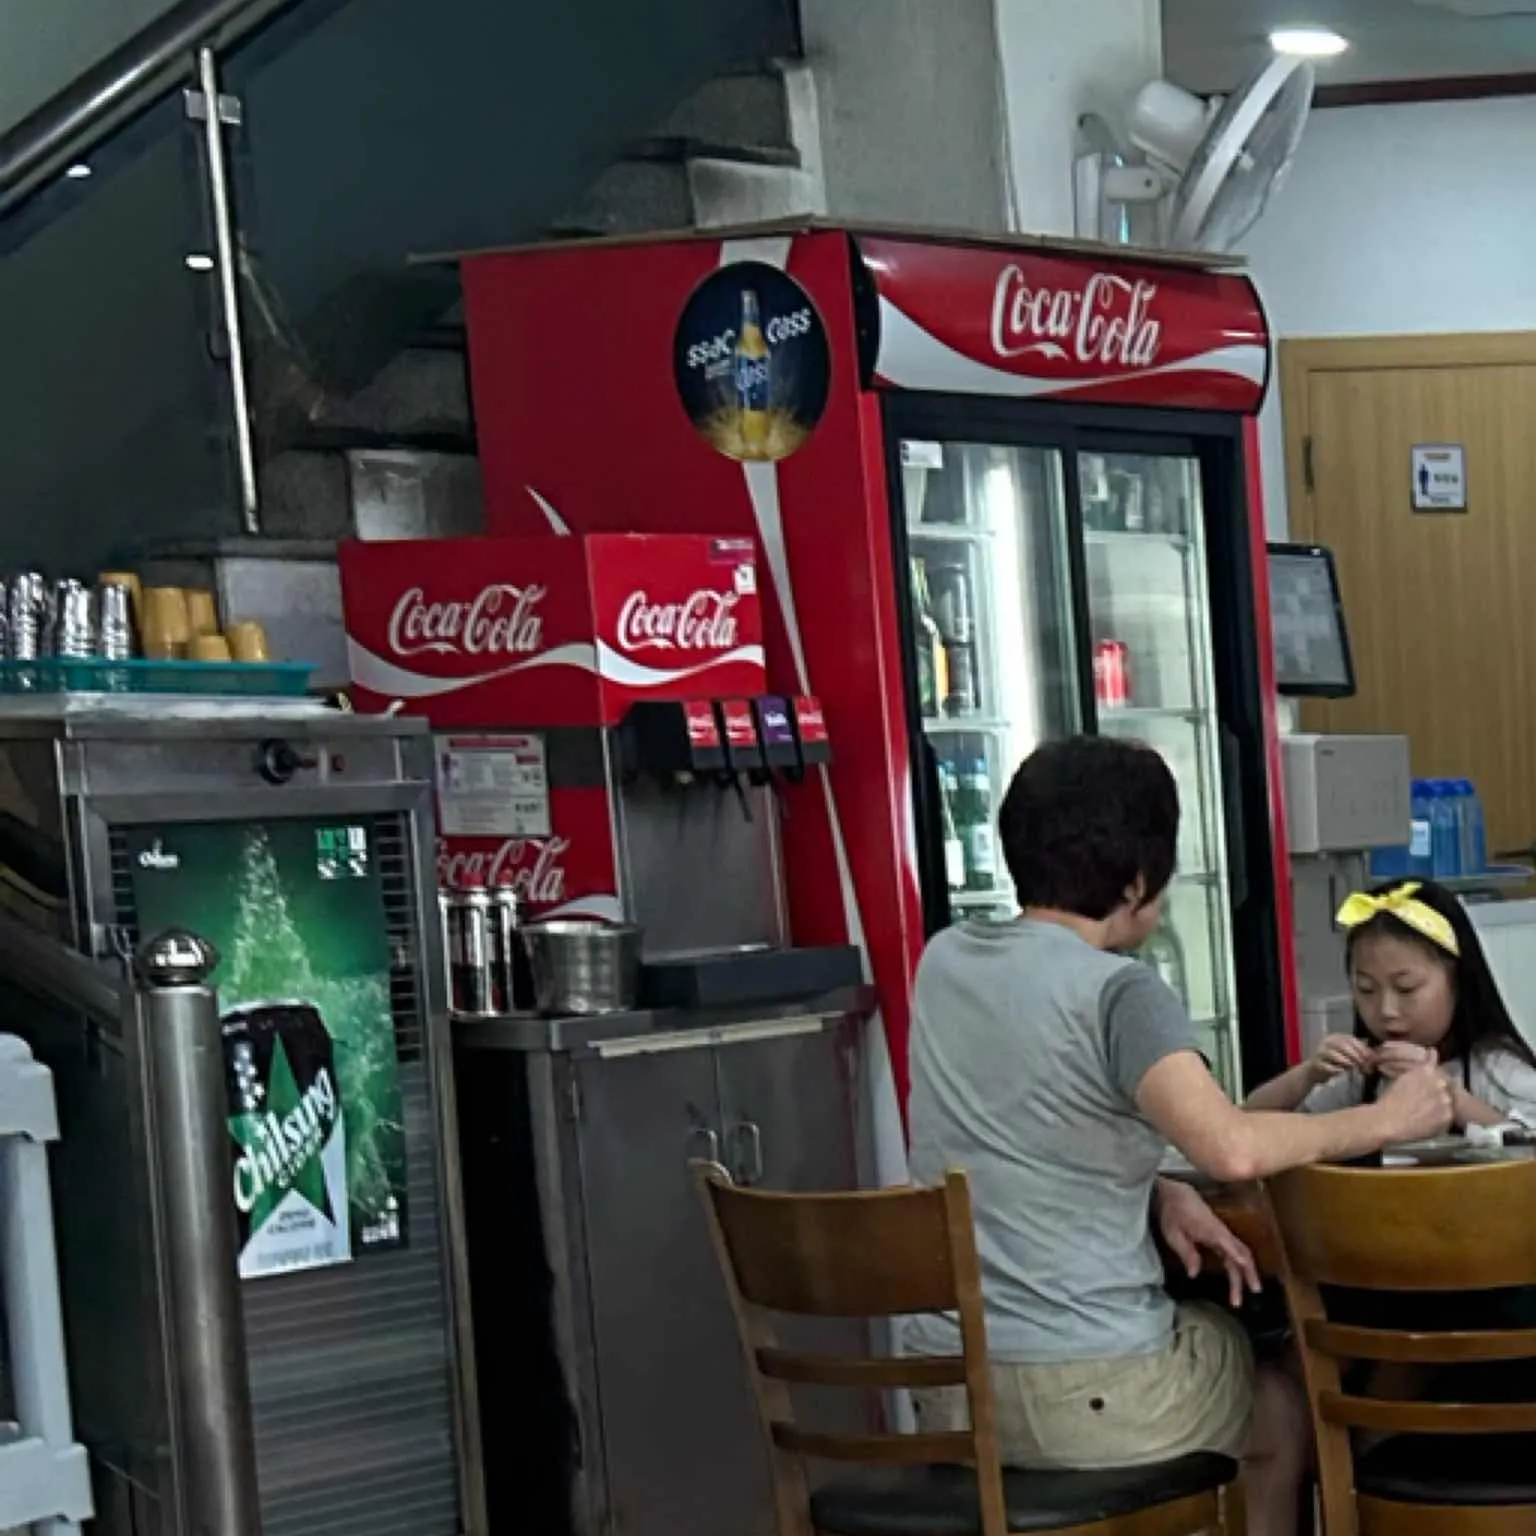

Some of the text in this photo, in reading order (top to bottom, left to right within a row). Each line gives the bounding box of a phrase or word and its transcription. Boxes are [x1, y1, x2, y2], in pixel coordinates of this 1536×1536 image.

[990, 263, 1161, 366] Coca-Cola
[388, 584, 547, 656] Coca-Cola
[617, 589, 741, 651] Coca-Cola
